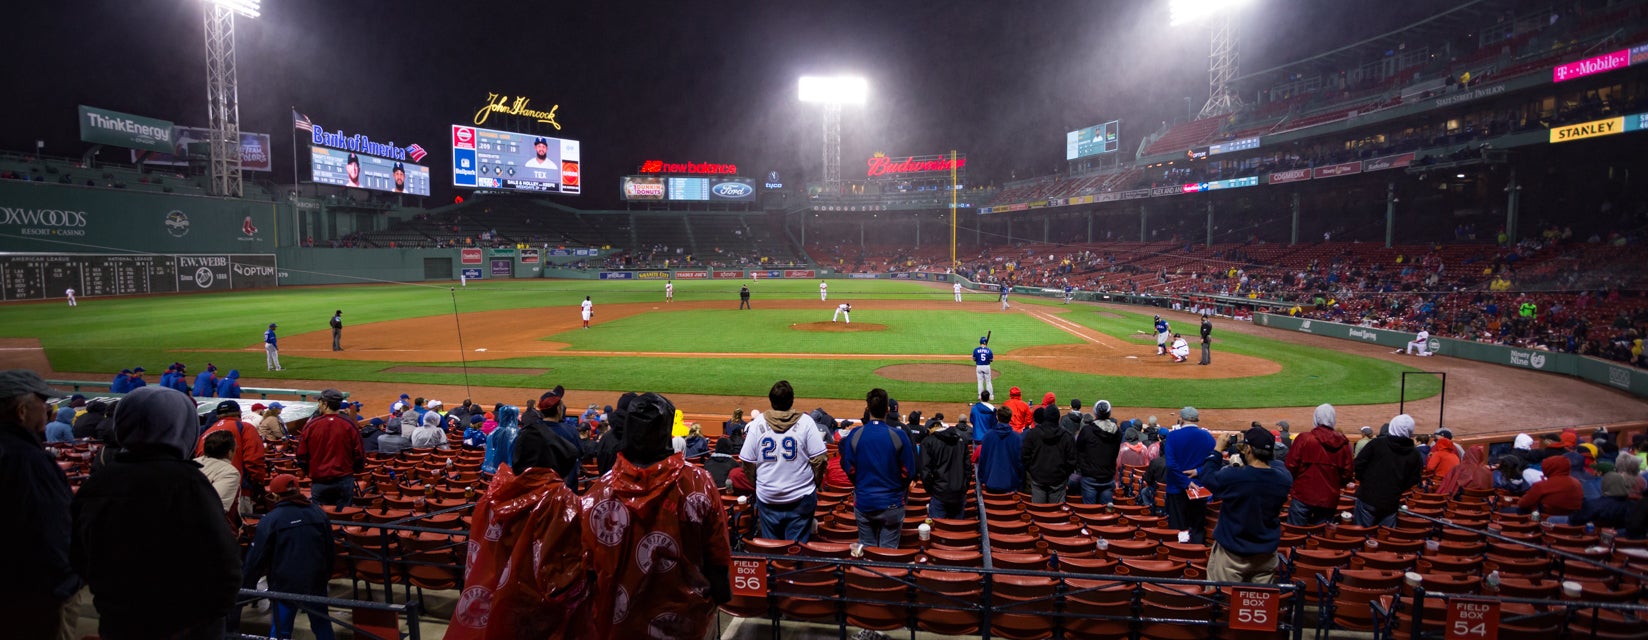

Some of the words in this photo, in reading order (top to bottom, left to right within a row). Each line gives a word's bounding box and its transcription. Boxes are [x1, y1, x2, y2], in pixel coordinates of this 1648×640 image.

[1474, 84, 1505, 97] PAVILION
[474, 92, 510, 125] John
[510, 96, 562, 130] Hancock
[87, 112, 169, 141] ThinkEnergy
[1558, 121, 1615, 139] STANLEY
[312, 124, 347, 150] Bank
[347, 133, 361, 151] of
[361, 136, 406, 160] America
[688, 161, 737, 175] balance
[720, 184, 745, 196] Ford
[21, 228, 51, 236] RESORT
[244, 266, 274, 276] OPTUM
[980, 353, 986, 361] 5
[1510, 350, 1530, 360] Ninety
[1510, 356, 1529, 366] Nine
[761, 436, 798, 462] 29
[733, 560, 759, 568] FIELD
[737, 567, 756, 575] BOX
[734, 576, 760, 590] 56
[1240, 591, 1270, 600] FIELD
[1242, 599, 1265, 607] BOX
[1456, 602, 1490, 612] FIELD
[1237, 608, 1268, 624] 55
[1460, 611, 1484, 620] BOX
[1453, 621, 1487, 637] 54
